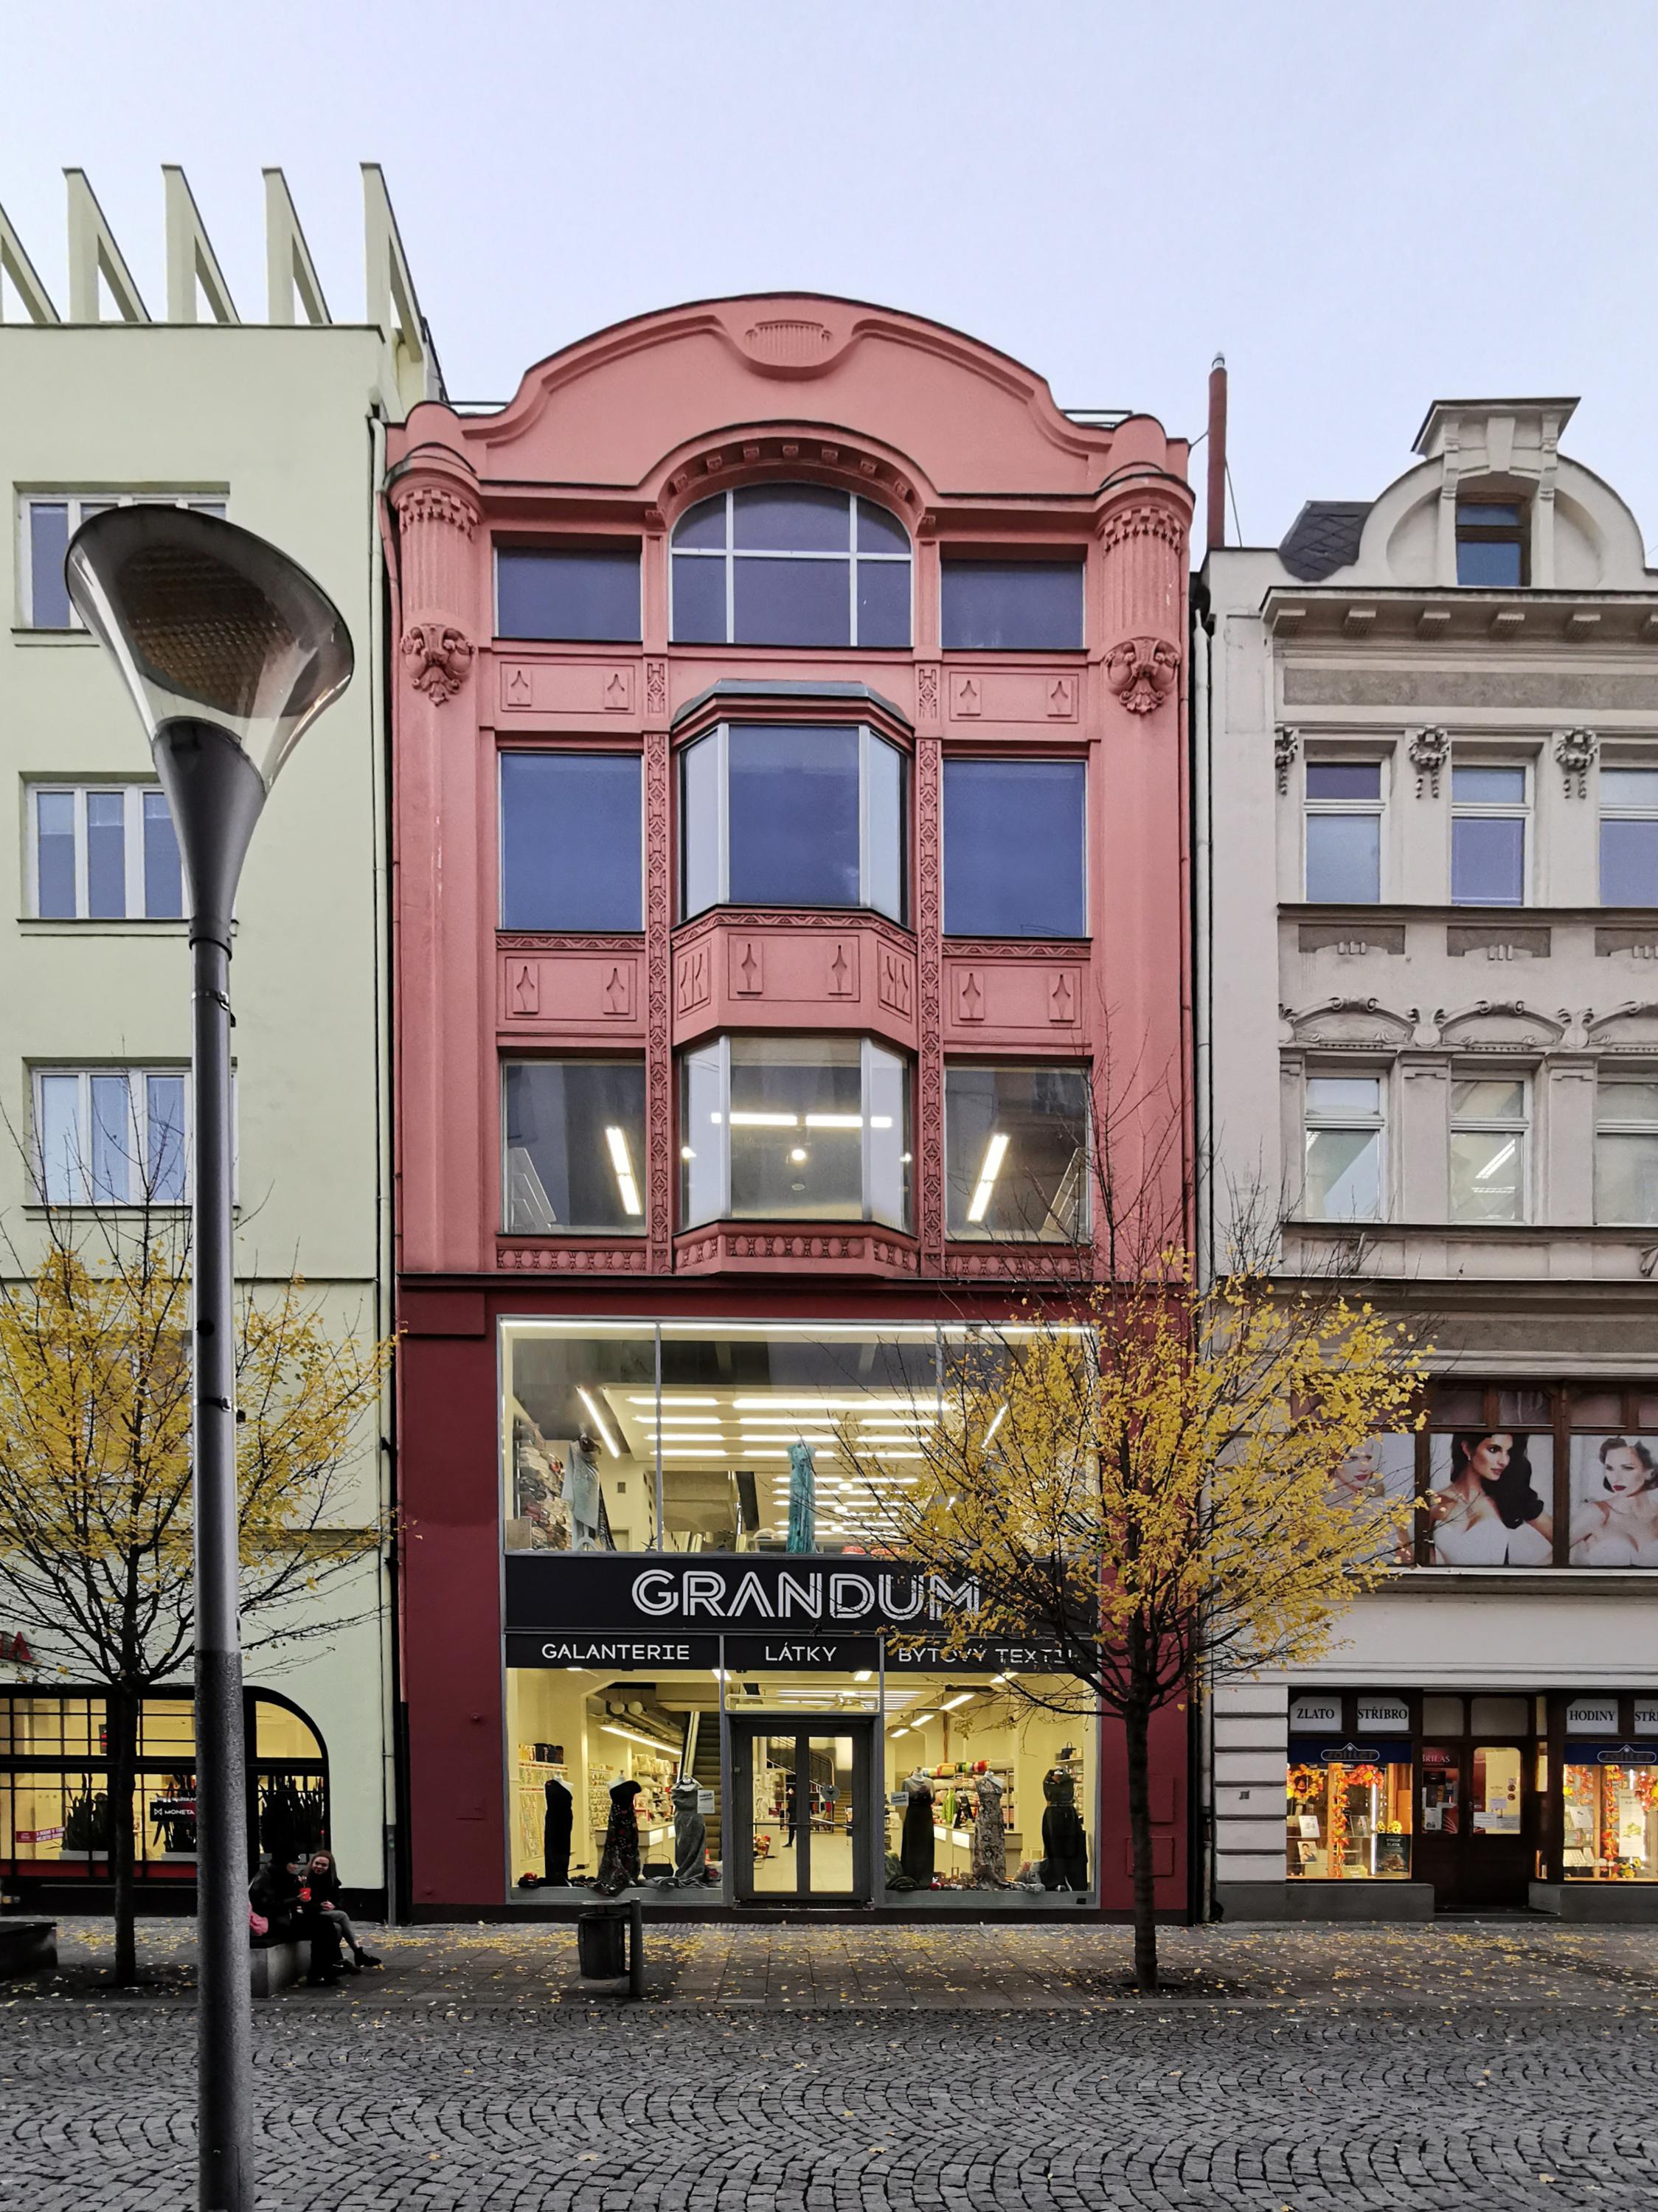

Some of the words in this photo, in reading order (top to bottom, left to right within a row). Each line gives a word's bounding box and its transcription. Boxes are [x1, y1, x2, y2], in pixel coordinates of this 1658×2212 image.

[631, 1568, 979, 1621] GRANDUM
[541, 1643, 690, 1660] GALANTERIE
[765, 1642, 837, 1662] LÁTKY
[1297, 1708, 1335, 1719] ZLATO
[1357, 1706, 1408, 1719] STŘÍBRO
[1569, 1710, 1615, 1721] HODINY
